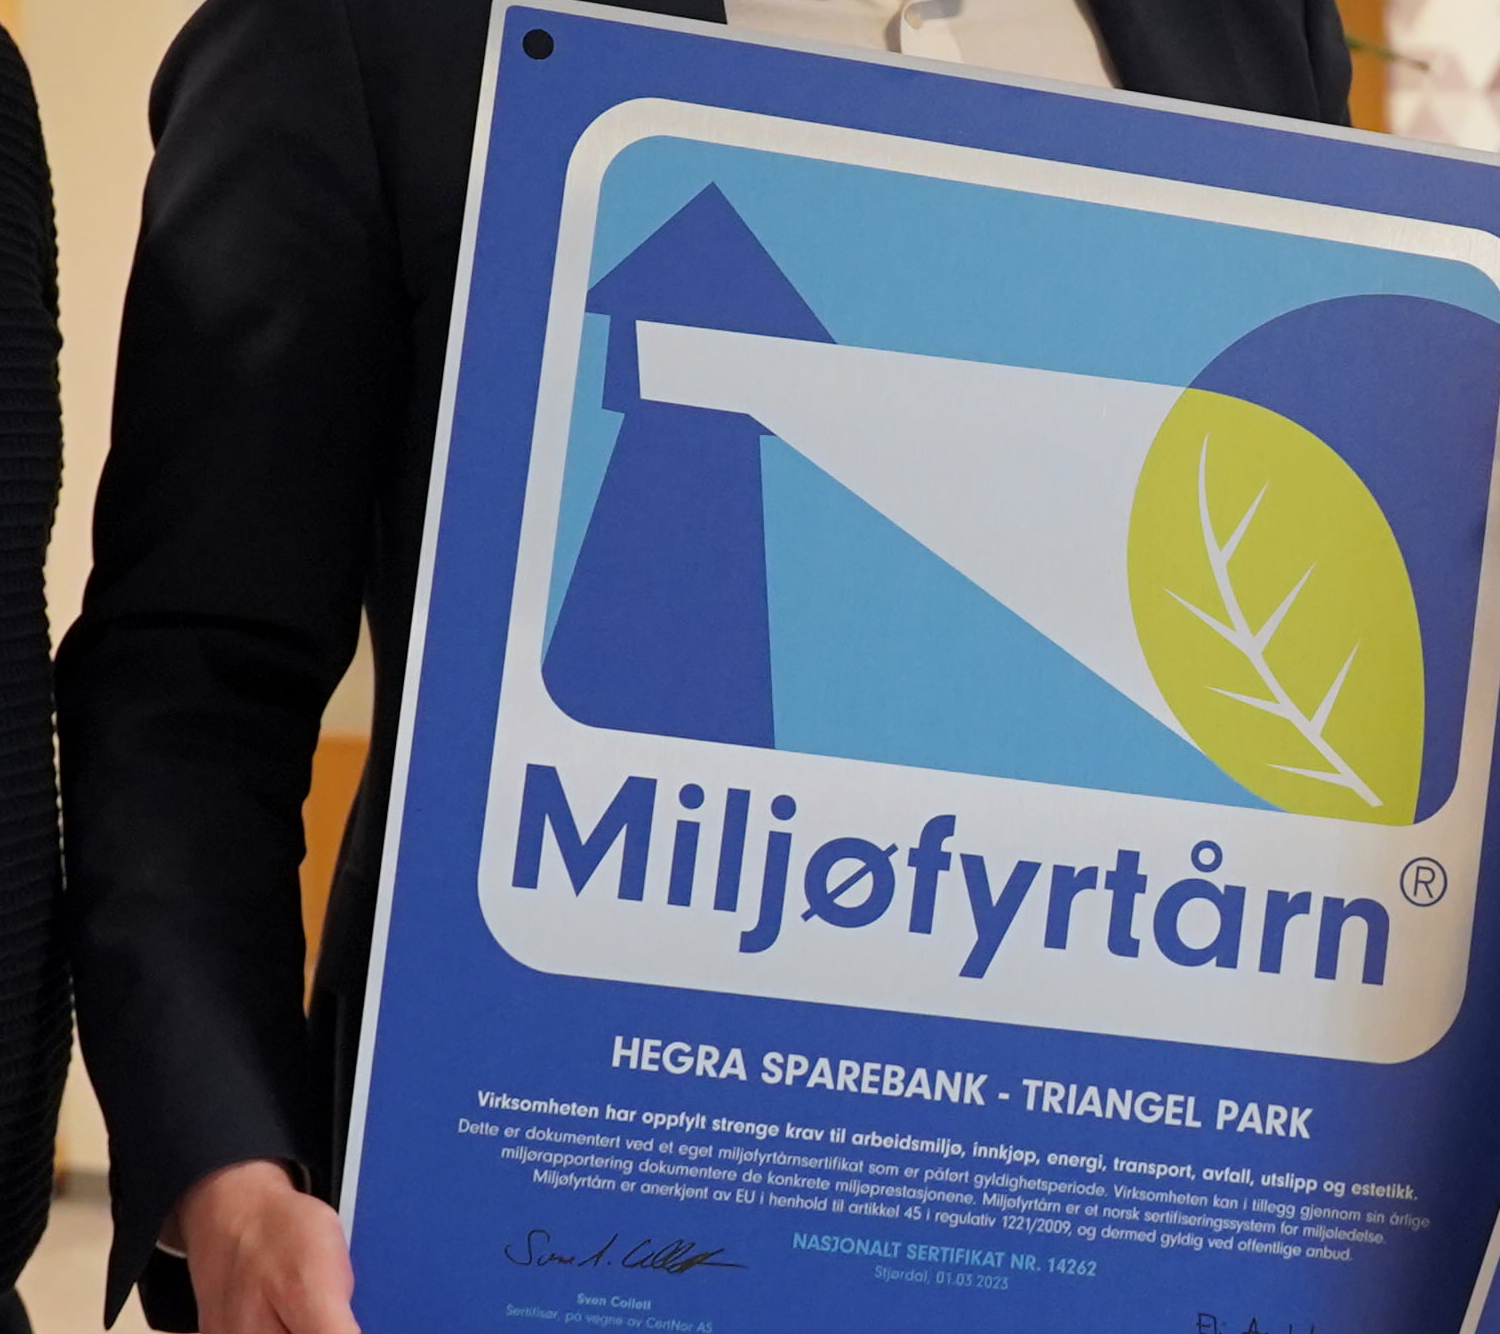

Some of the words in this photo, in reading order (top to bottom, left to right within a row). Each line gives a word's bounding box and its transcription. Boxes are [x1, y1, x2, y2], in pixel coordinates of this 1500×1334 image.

[610, 1034, 748, 1081] HEGRA
[759, 1050, 989, 1106] SPAREBANK
[1020, 1077, 1202, 1129] TRIANGEL
[1214, 1097, 1314, 1140] PARK
[456, 1116, 500, 1137] Dette
[502, 1125, 521, 1138] er
[523, 1124, 621, 1149] dokumentert
[624, 1136, 655, 1152] ved
[657, 1139, 674, 1155] et
[676, 1142, 714, 1161] eget
[866, 1162, 900, 1177] som
[902, 1165, 920, 1179] er
[922, 1165, 970, 1184] påført
[1112, 1182, 1209, 1207] Virksomheten
[1211, 1193, 1239, 1210] kan
[1250, 1197, 1296, 1220] tillegg
[1298, 1202, 1362, 1222] gjennom
[1364, 1209, 1386, 1224] sin
[1387, 1210, 1431, 1232] årlige
[476, 1089, 600, 1119] Virksomheten
[604, 1102, 638, 1123] har
[640, 1110, 707, 1133] oppfylt
[710, 1116, 780, 1141] strenge
[784, 1121, 825, 1142] krav
[828, 1126, 847, 1144] til
[850, 1129, 966, 1159] arbeidsmiljø,
[971, 1140, 1041, 1167] innkjøp,
[1045, 1151, 1107, 1174] energi,
[1112, 1155, 1196, 1182] transport,
[1200, 1165, 1255, 1187] avfall,
[1259, 1171, 1318, 1195] utslipp
[1321, 1179, 1346, 1199] og
[1349, 1181, 1418, 1201] estetikk.
[531, 1167, 617, 1191] Miljøfyrtårn
[619, 1179, 637, 1193] er
[638, 1181, 709, 1202] anerkjent
[711, 1188, 732, 1202] av
[734, 1187, 756, 1205] EU
[767, 1190, 828, 1212] henhold
[830, 1197, 845, 1213] til
[846, 1200, 901, 1219] artikkel
[902, 1204, 923, 1221] 45
[933, 1209, 997, 1228] regulativ
[1075, 1224, 1097, 1242] og
[1099, 1223, 1157, 1244] dermed
[1159, 1230, 1204, 1252] gyldig
[1206, 1234, 1235, 1251] ved
[1236, 1237, 1303, 1260] offentlige
[637, 1157, 738, 1182] dokumentere
[740, 1167, 763, 1184] de
[765, 1169, 831, 1191] konkrete
[981, 1190, 1062, 1213] Miljøfyrtårn
[1064, 1202, 1081, 1215] er
[1082, 1202, 1099, 1218] et
[1101, 1205, 1140, 1221] norsk
[1279, 1219, 1300, 1236] for
[791, 1231, 902, 1259] NASJONALT
[905, 1242, 1006, 1268] SERTIFIKAT
[1009, 1252, 1042, 1272] NR.
[1046, 1255, 1098, 1277] 14262
